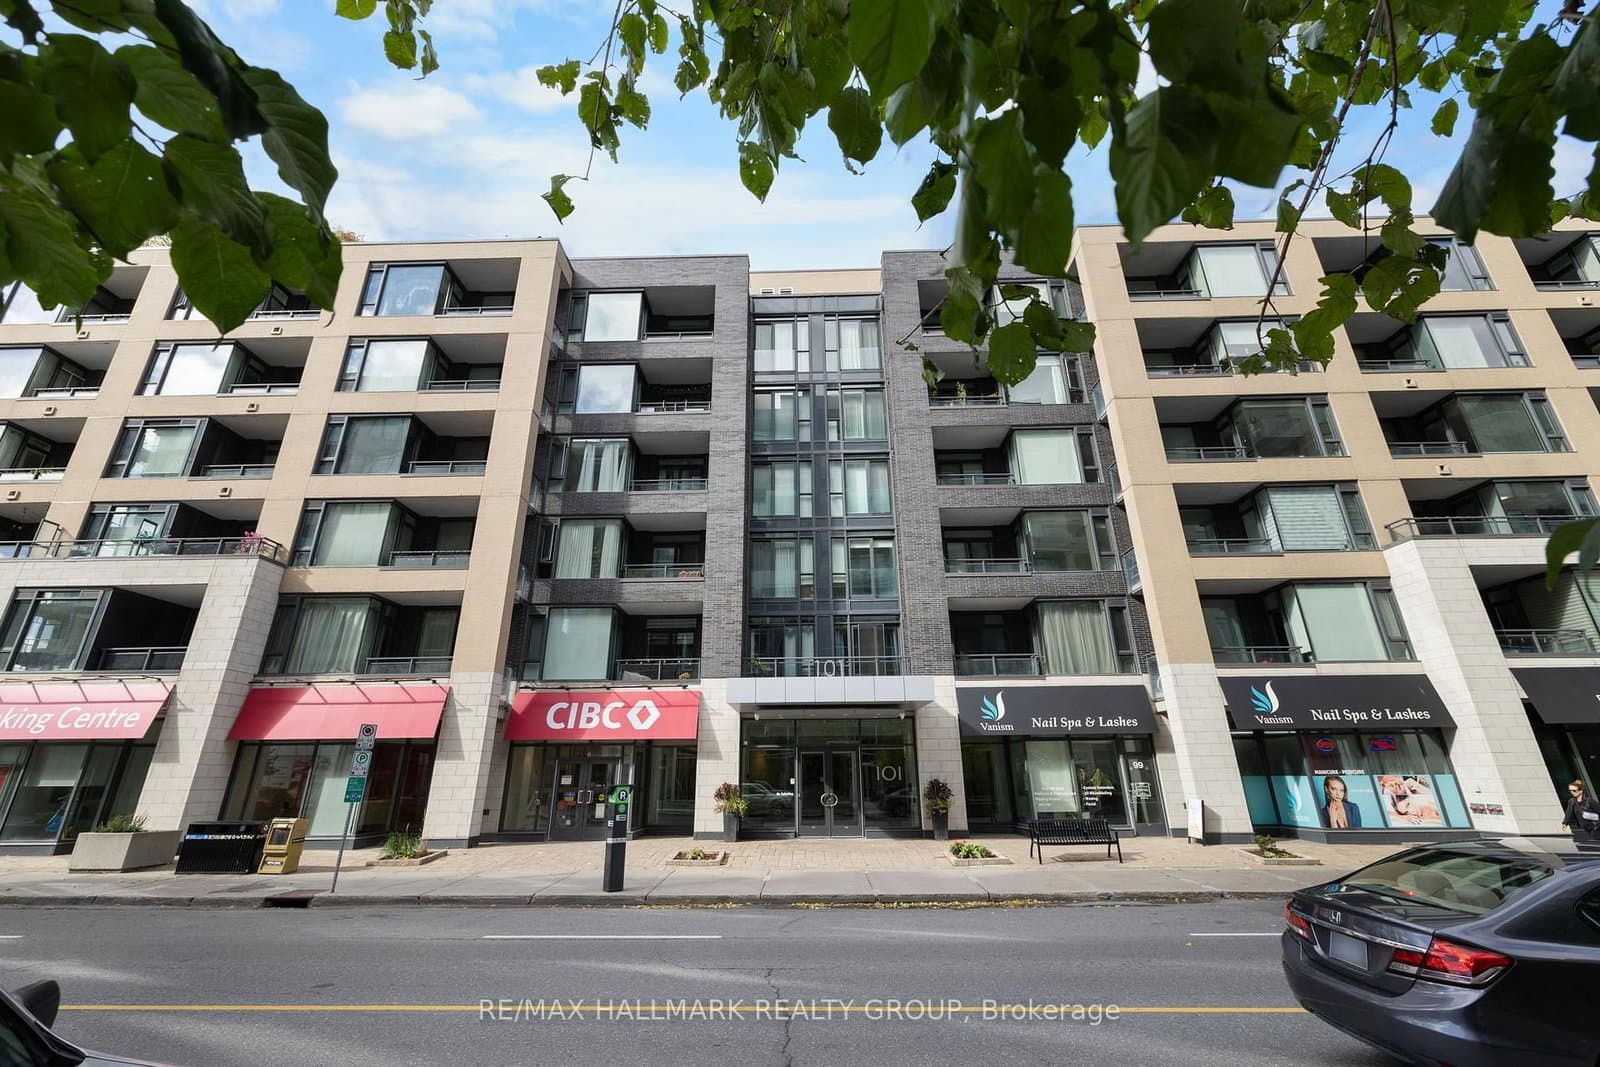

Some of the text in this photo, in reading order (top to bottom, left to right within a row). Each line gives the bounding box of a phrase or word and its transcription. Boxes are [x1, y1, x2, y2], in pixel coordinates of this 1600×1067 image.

[814, 659, 844, 678] 101
[0, 705, 141, 734] king Centre
[546, 701, 624, 730] CIBC
[1255, 715, 1294, 725] Vanism
[1310, 707, 1431, 724] Nail Spa & Lashes
[980, 722, 1014, 732] Vanism
[1031, 716, 1138, 731] Nail Spa & Lashes
[1132, 761, 1144, 769] 99
[875, 766, 903, 781] 101
